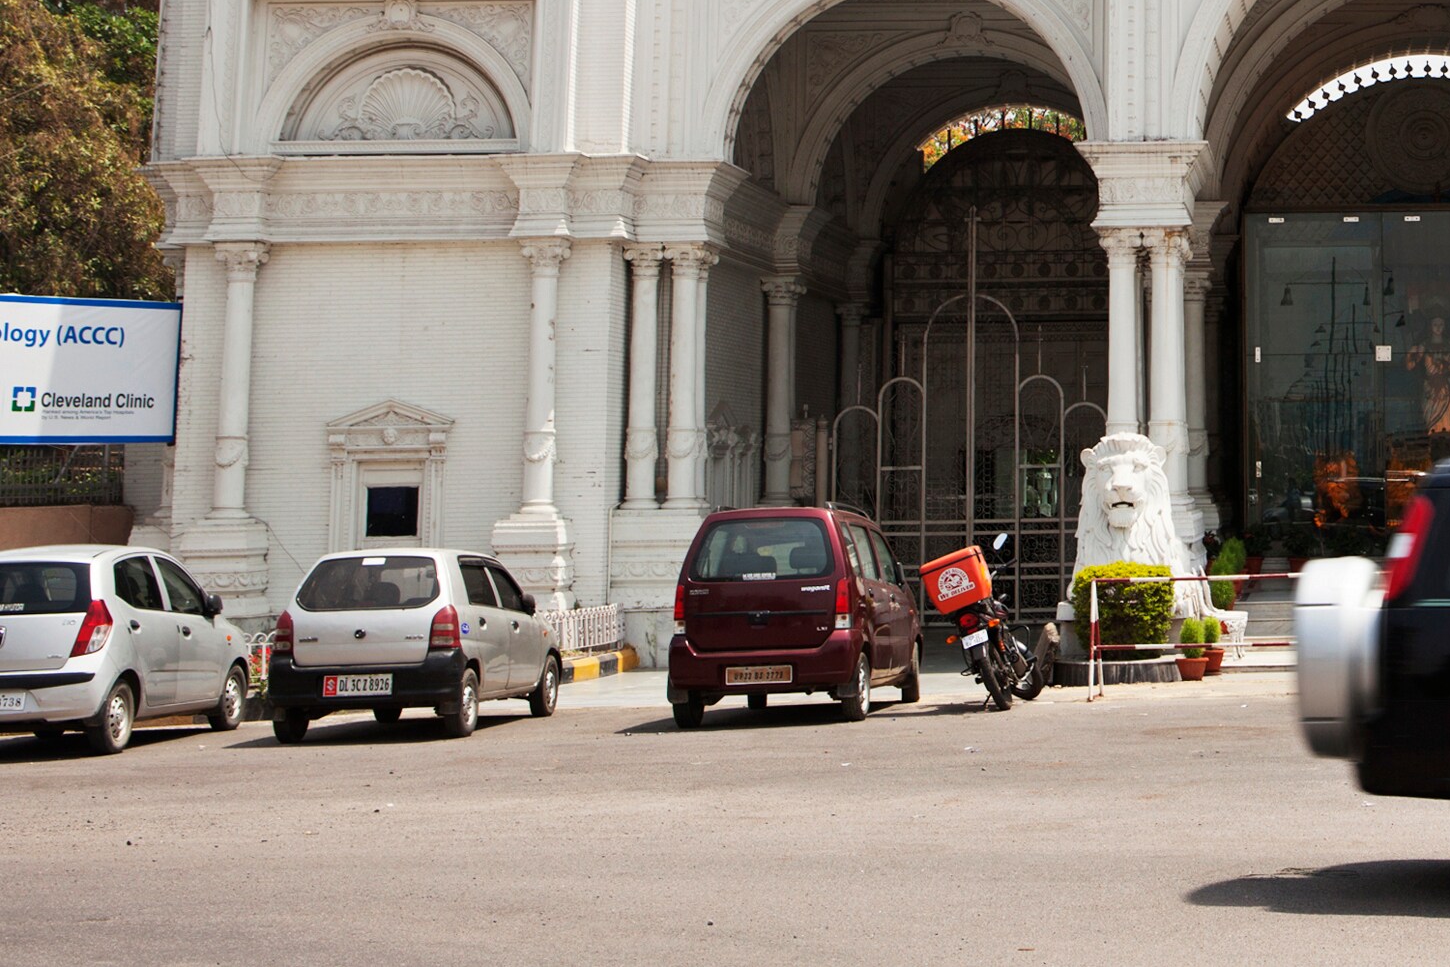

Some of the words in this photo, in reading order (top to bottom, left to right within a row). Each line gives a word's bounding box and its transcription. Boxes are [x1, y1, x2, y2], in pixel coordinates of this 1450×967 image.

[0, 322, 51, 347] logy
[56, 325, 125, 348] (ACCC)
[41, 392, 112, 408] Cleveland
[115, 393, 155, 409] Clinic
